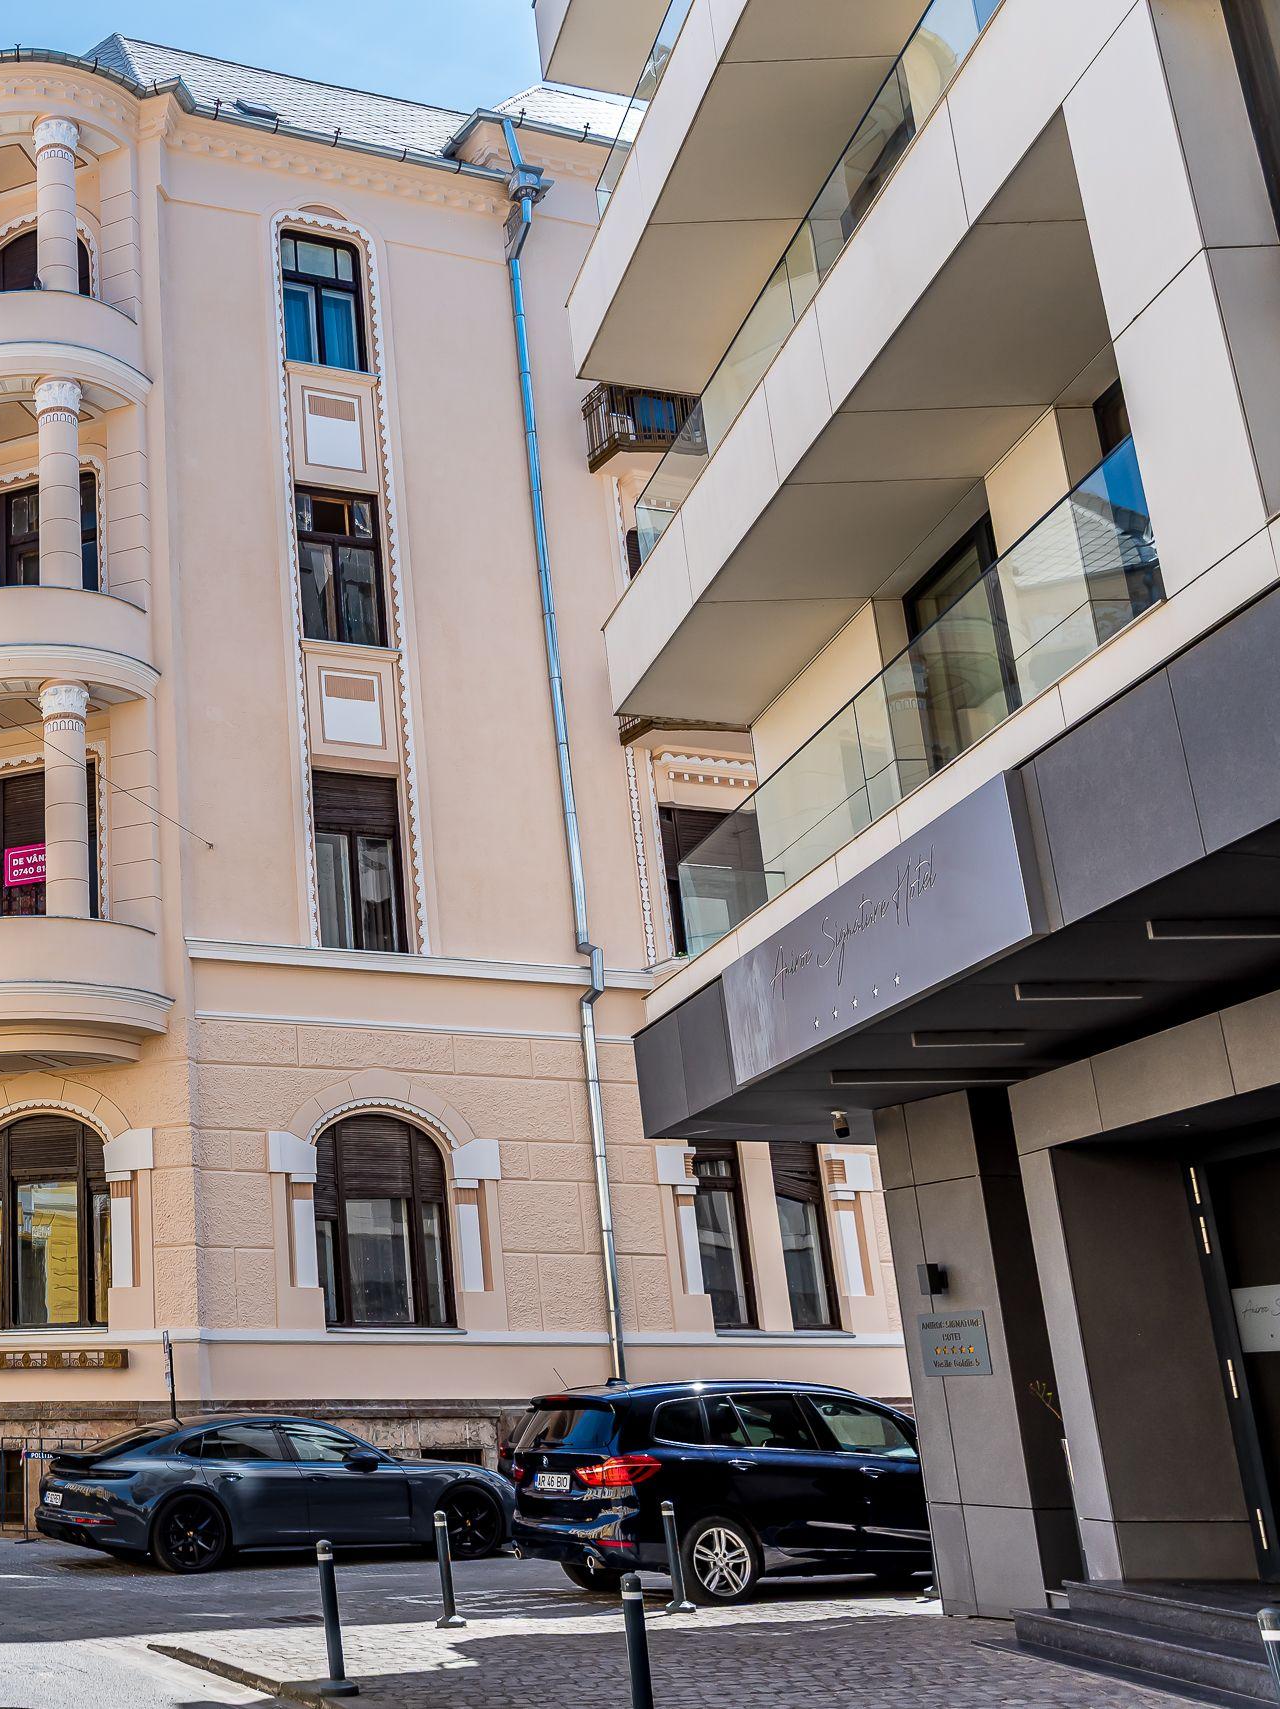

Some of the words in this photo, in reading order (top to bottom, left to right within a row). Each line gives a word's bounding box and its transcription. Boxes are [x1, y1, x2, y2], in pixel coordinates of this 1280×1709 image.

[12, 858, 24, 866] DE
[26, 854, 46, 864] VÂN
[12, 867, 35, 876] 0740
[36, 865, 46, 873] 81
[817, 893, 889, 987] Signature
[892, 844, 936, 926] Hotel
